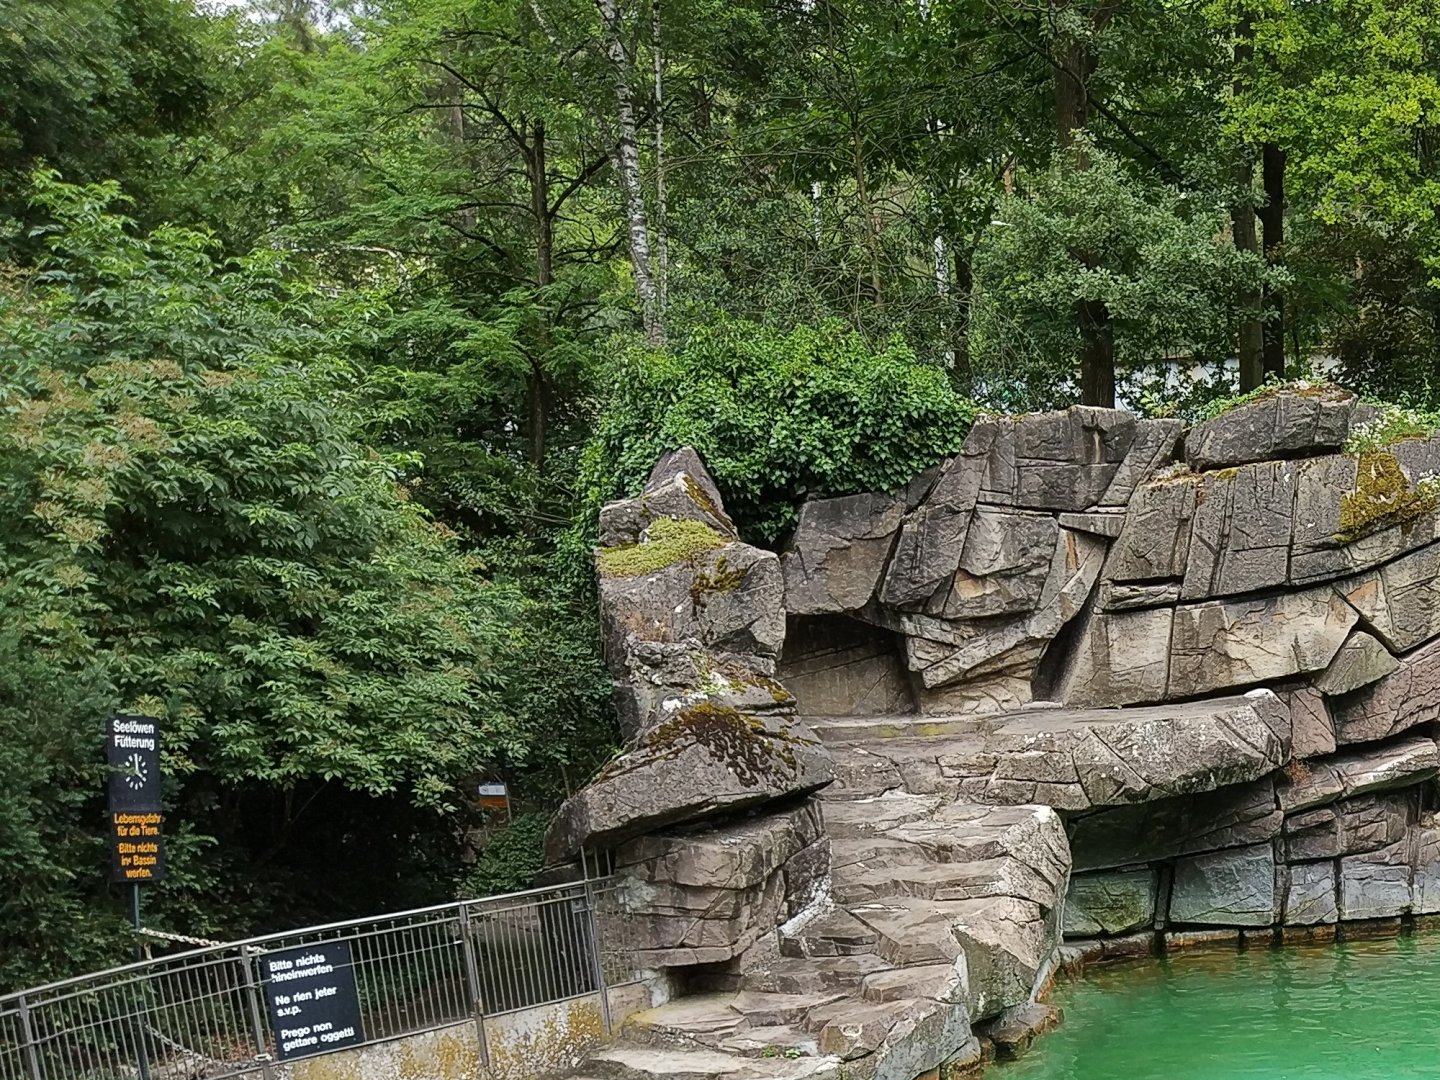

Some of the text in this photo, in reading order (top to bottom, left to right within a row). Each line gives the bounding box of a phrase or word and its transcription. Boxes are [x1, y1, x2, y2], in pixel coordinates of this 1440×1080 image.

[113, 720, 155, 734] Seelöwen
[114, 735, 155, 751] Fütterung
[117, 826, 128, 836] für
[118, 842, 158, 853] Bitte nichts
[133, 855, 157, 866] Bassin
[269, 954, 326, 972] Bitte nichts
[271, 964, 333, 983] hineinwerfen
[275, 986, 337, 1006] Ne rien jeter
[277, 1005, 302, 1017] s.v.p.
[281, 1022, 333, 1040] Prego non
[283, 1026, 355, 1052] gettare oggetti
